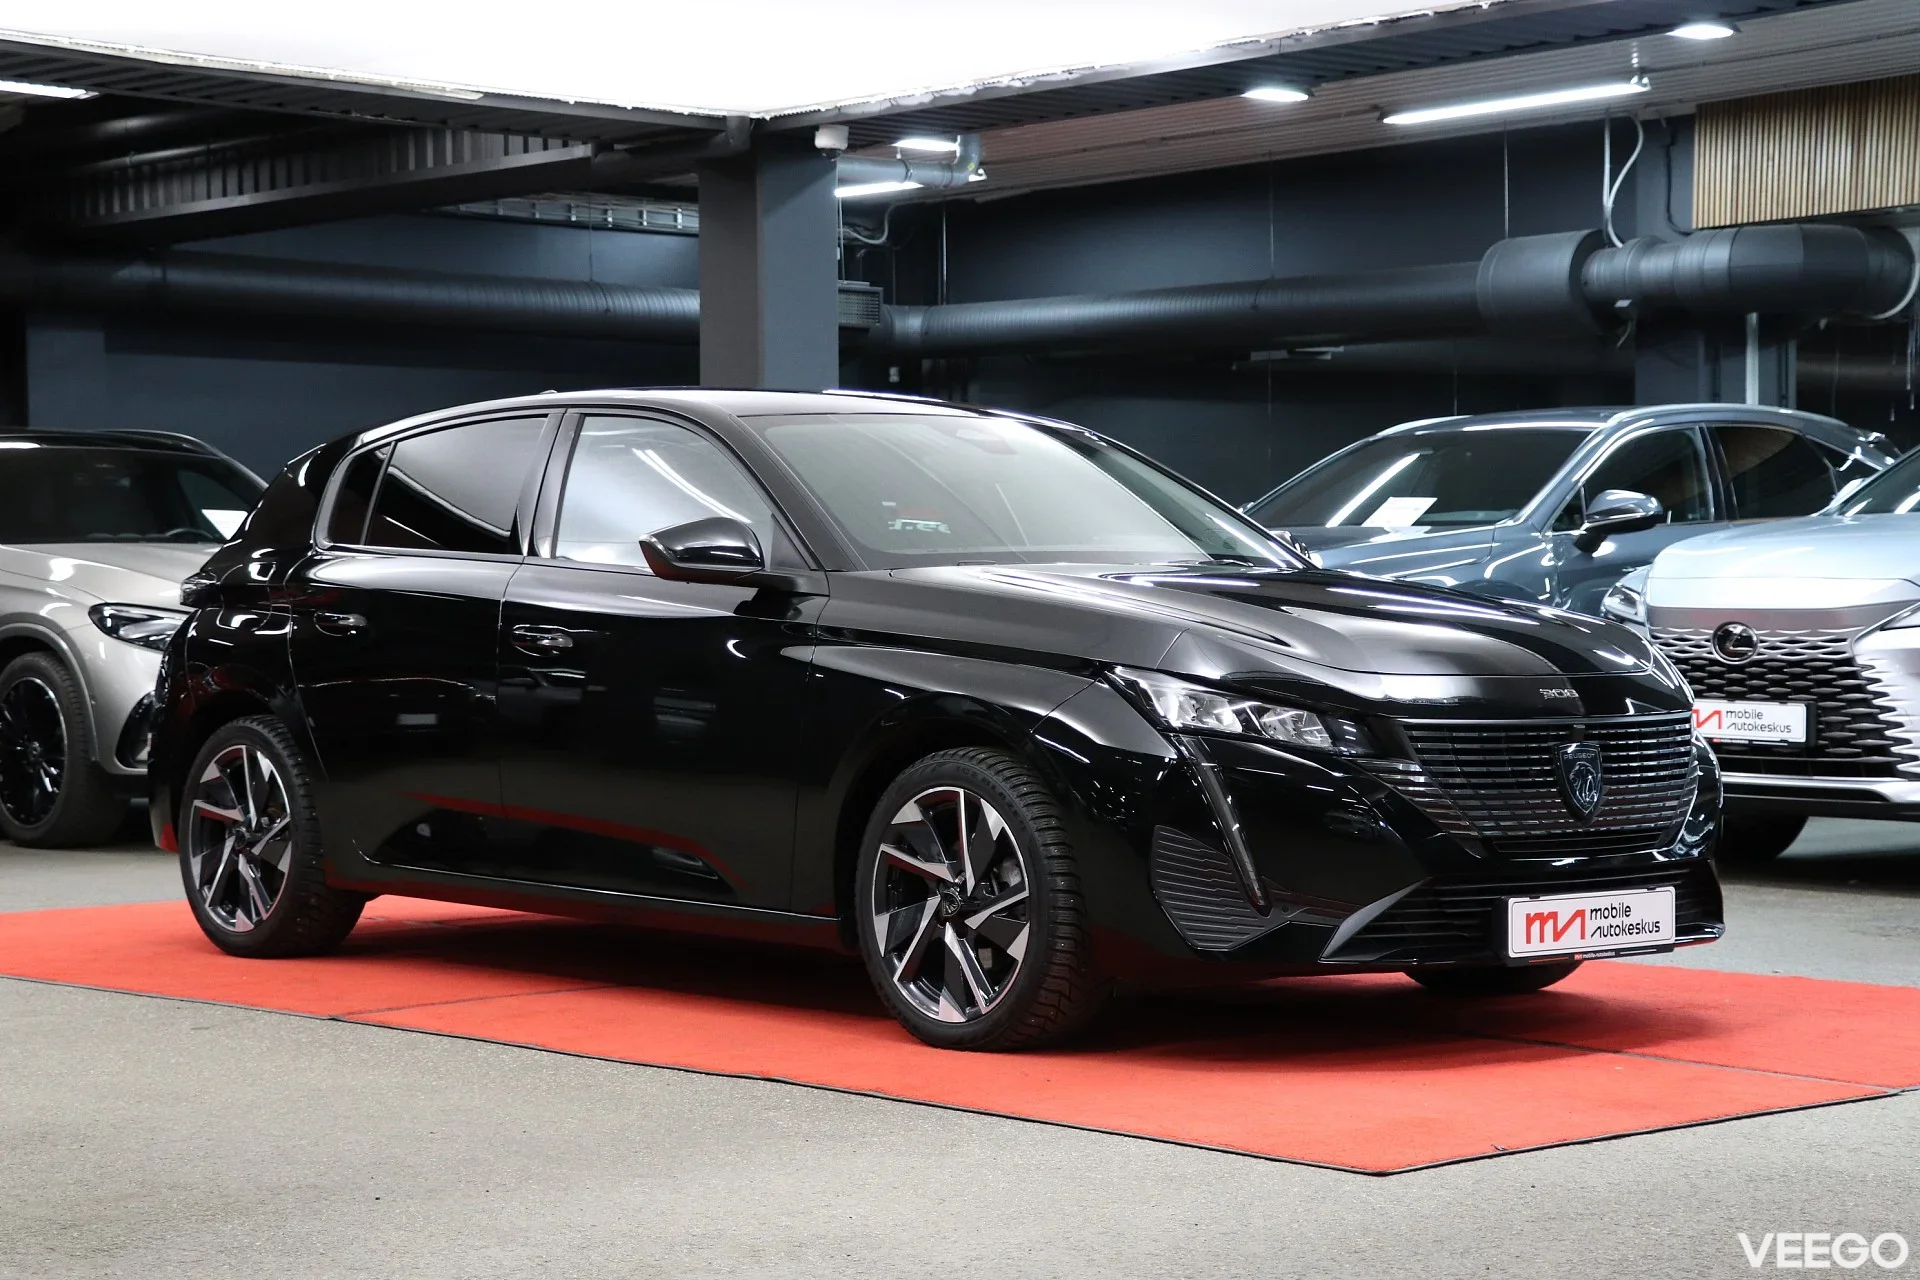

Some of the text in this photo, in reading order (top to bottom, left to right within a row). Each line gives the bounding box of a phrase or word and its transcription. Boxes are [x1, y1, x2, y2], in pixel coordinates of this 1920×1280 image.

[1539, 688, 1579, 700] 308
[1725, 708, 1764, 720] mobile
[1563, 752, 1596, 760] PEUGEOT
[1589, 901, 1632, 921] mobile
